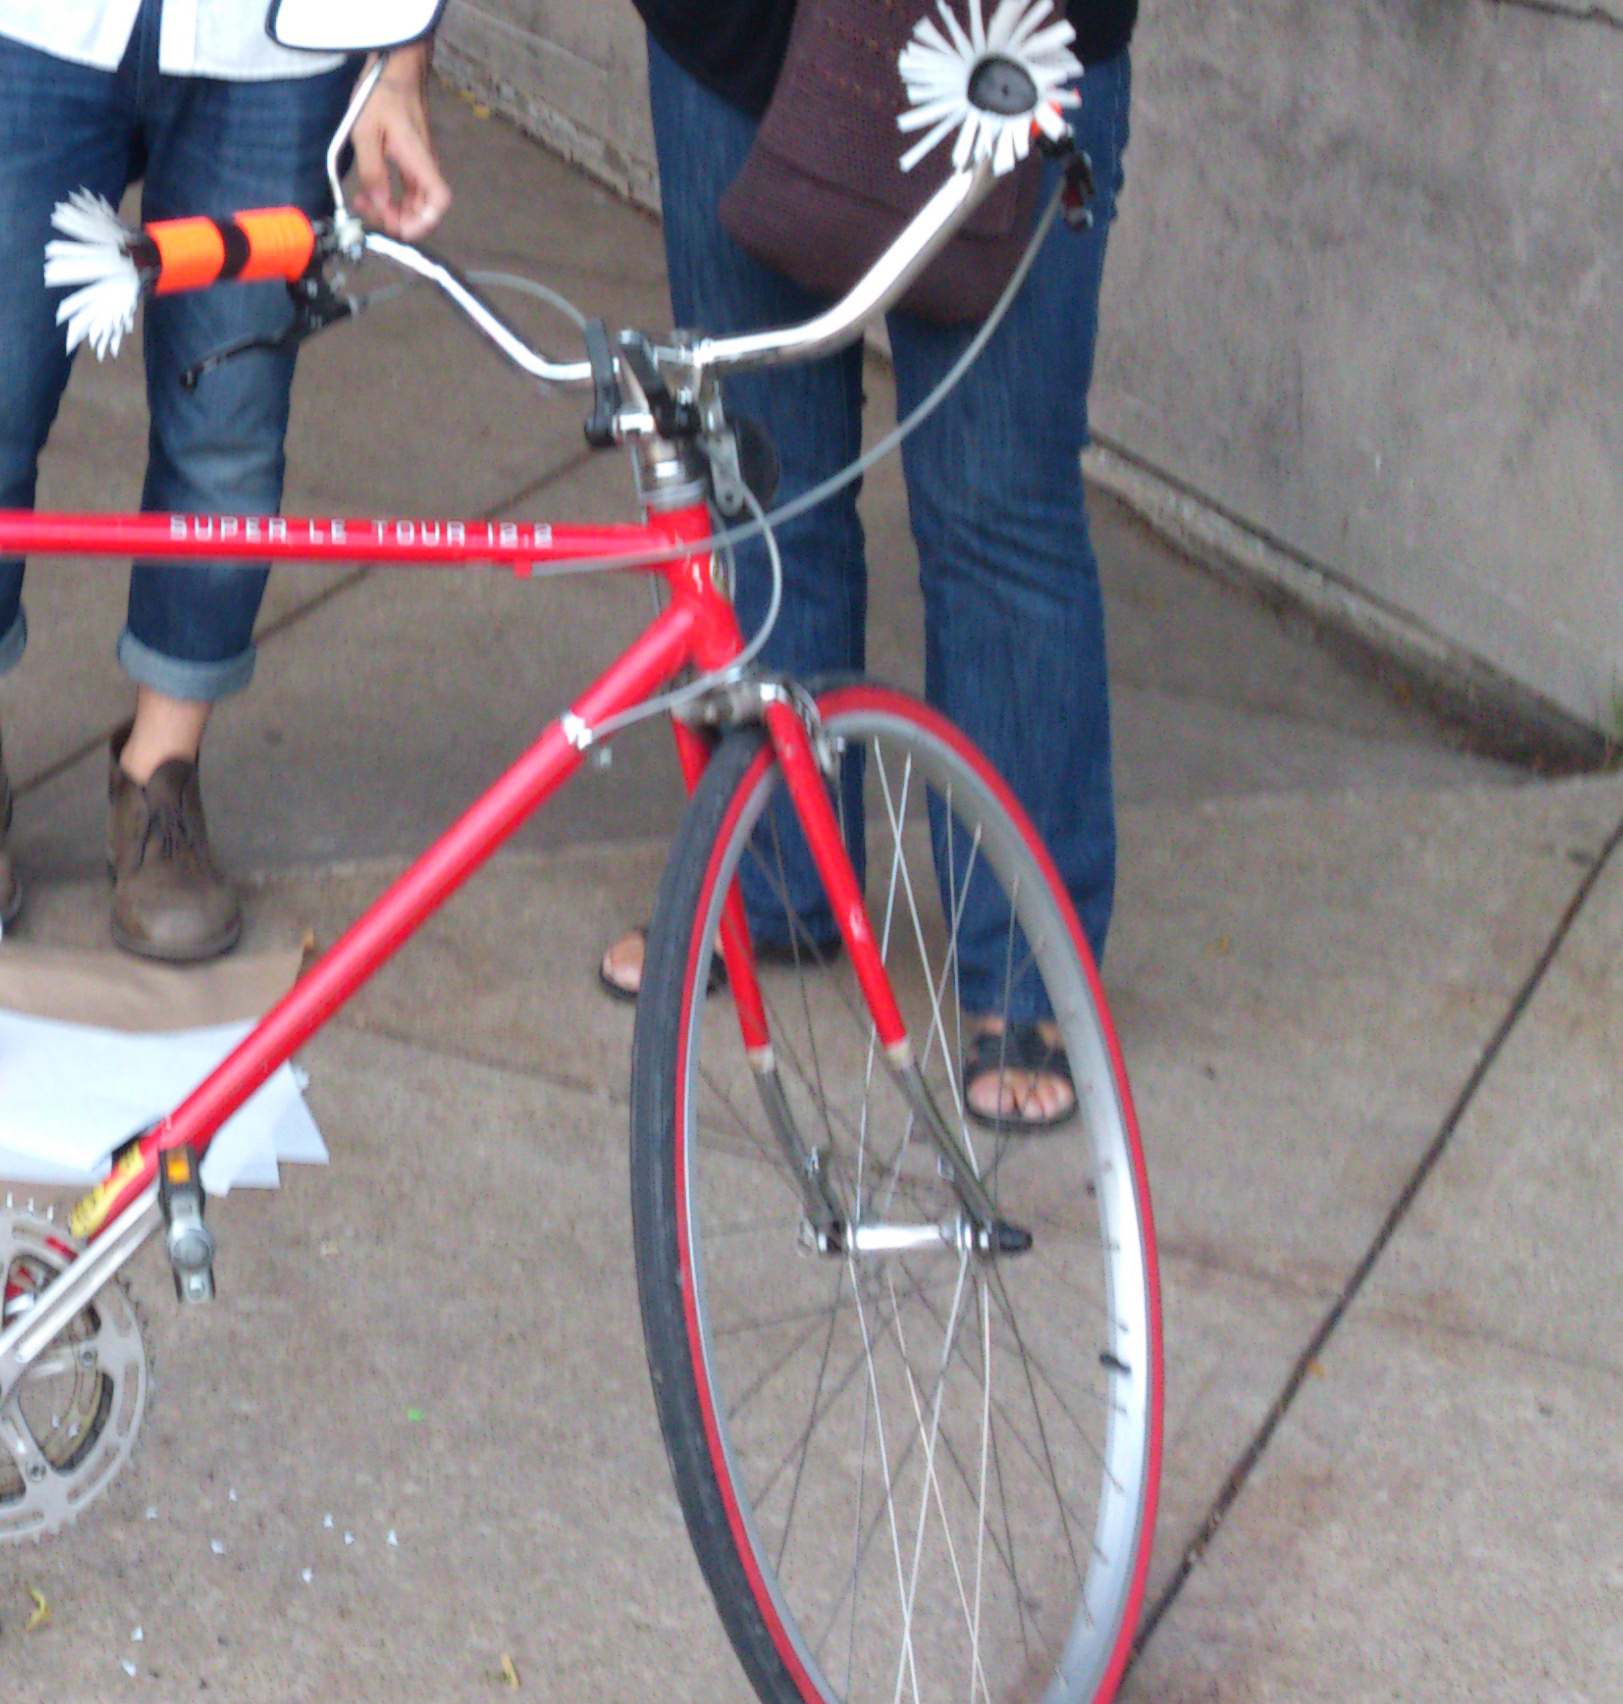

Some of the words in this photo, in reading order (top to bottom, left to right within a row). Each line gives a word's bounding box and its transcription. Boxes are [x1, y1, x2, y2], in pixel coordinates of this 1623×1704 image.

[170, 515, 286, 544] SUPER
[309, 517, 347, 545] LE
[372, 520, 465, 547] TOUR
